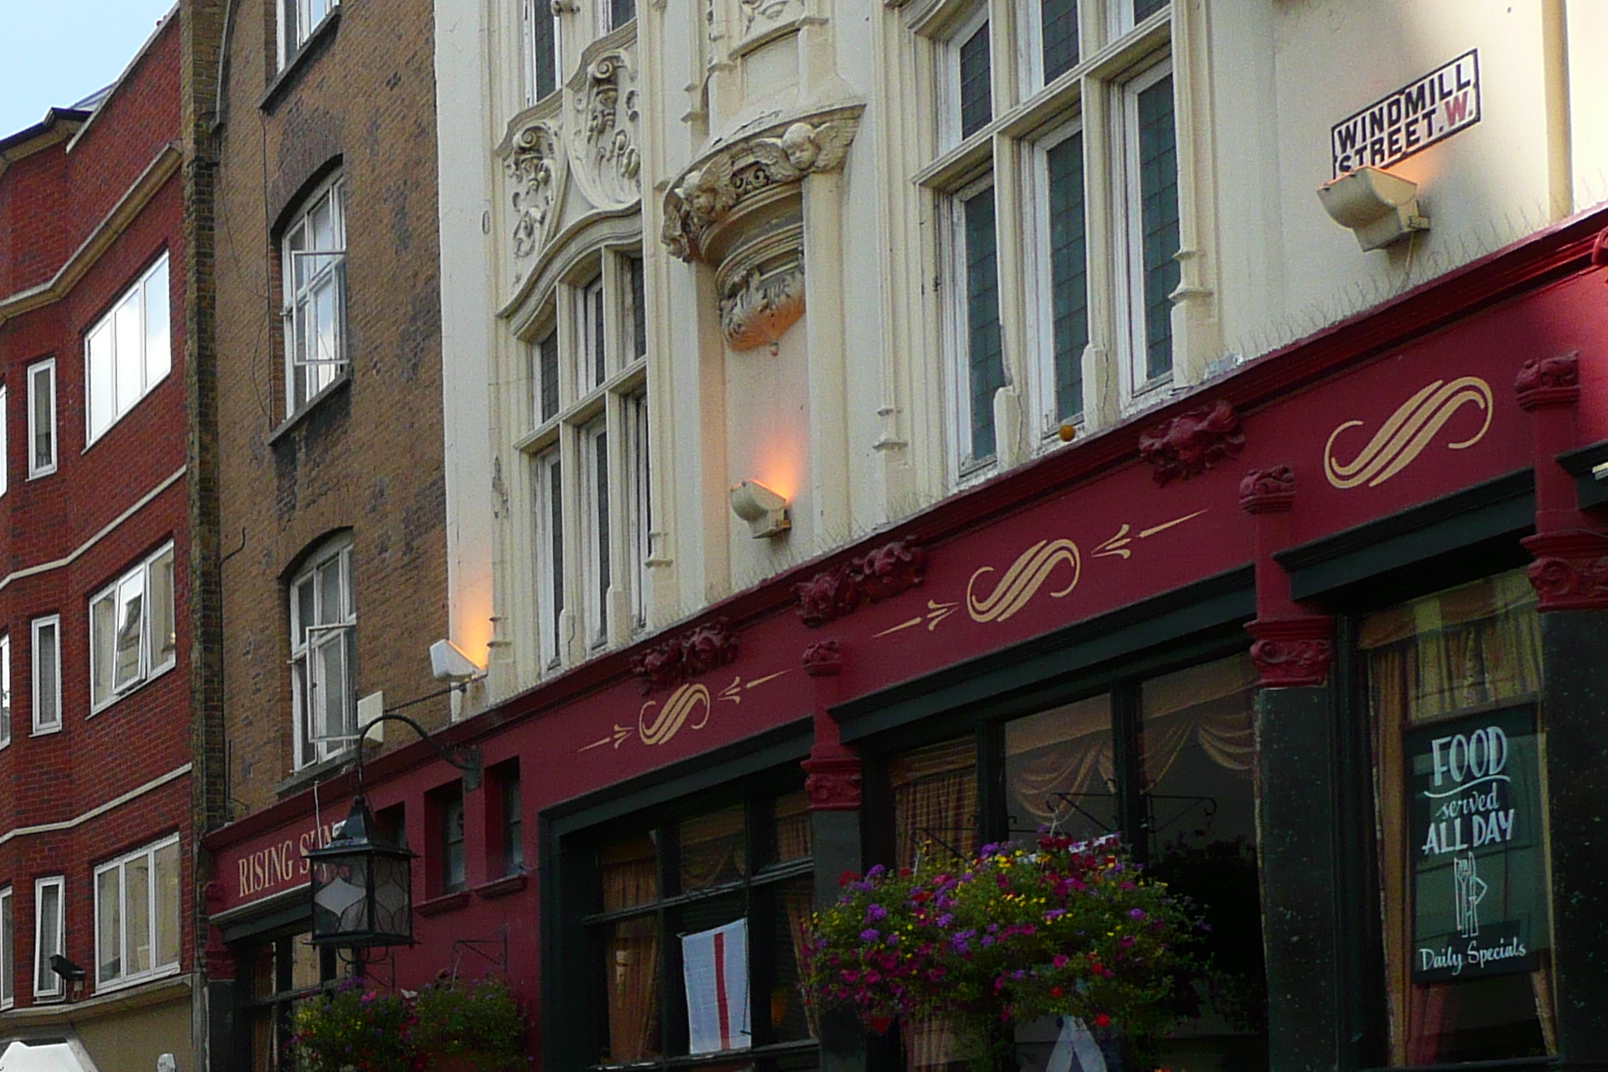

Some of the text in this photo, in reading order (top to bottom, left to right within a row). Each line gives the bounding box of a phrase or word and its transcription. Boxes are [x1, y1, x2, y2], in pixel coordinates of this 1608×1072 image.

[1337, 63, 1471, 154] WINDMILL
[1431, 726, 1507, 786] FOOD
[1436, 782, 1500, 818] served
[1422, 809, 1516, 855] ALL DAY
[238, 840, 293, 898] RISING
[1419, 936, 1527, 977] Daily Specials
